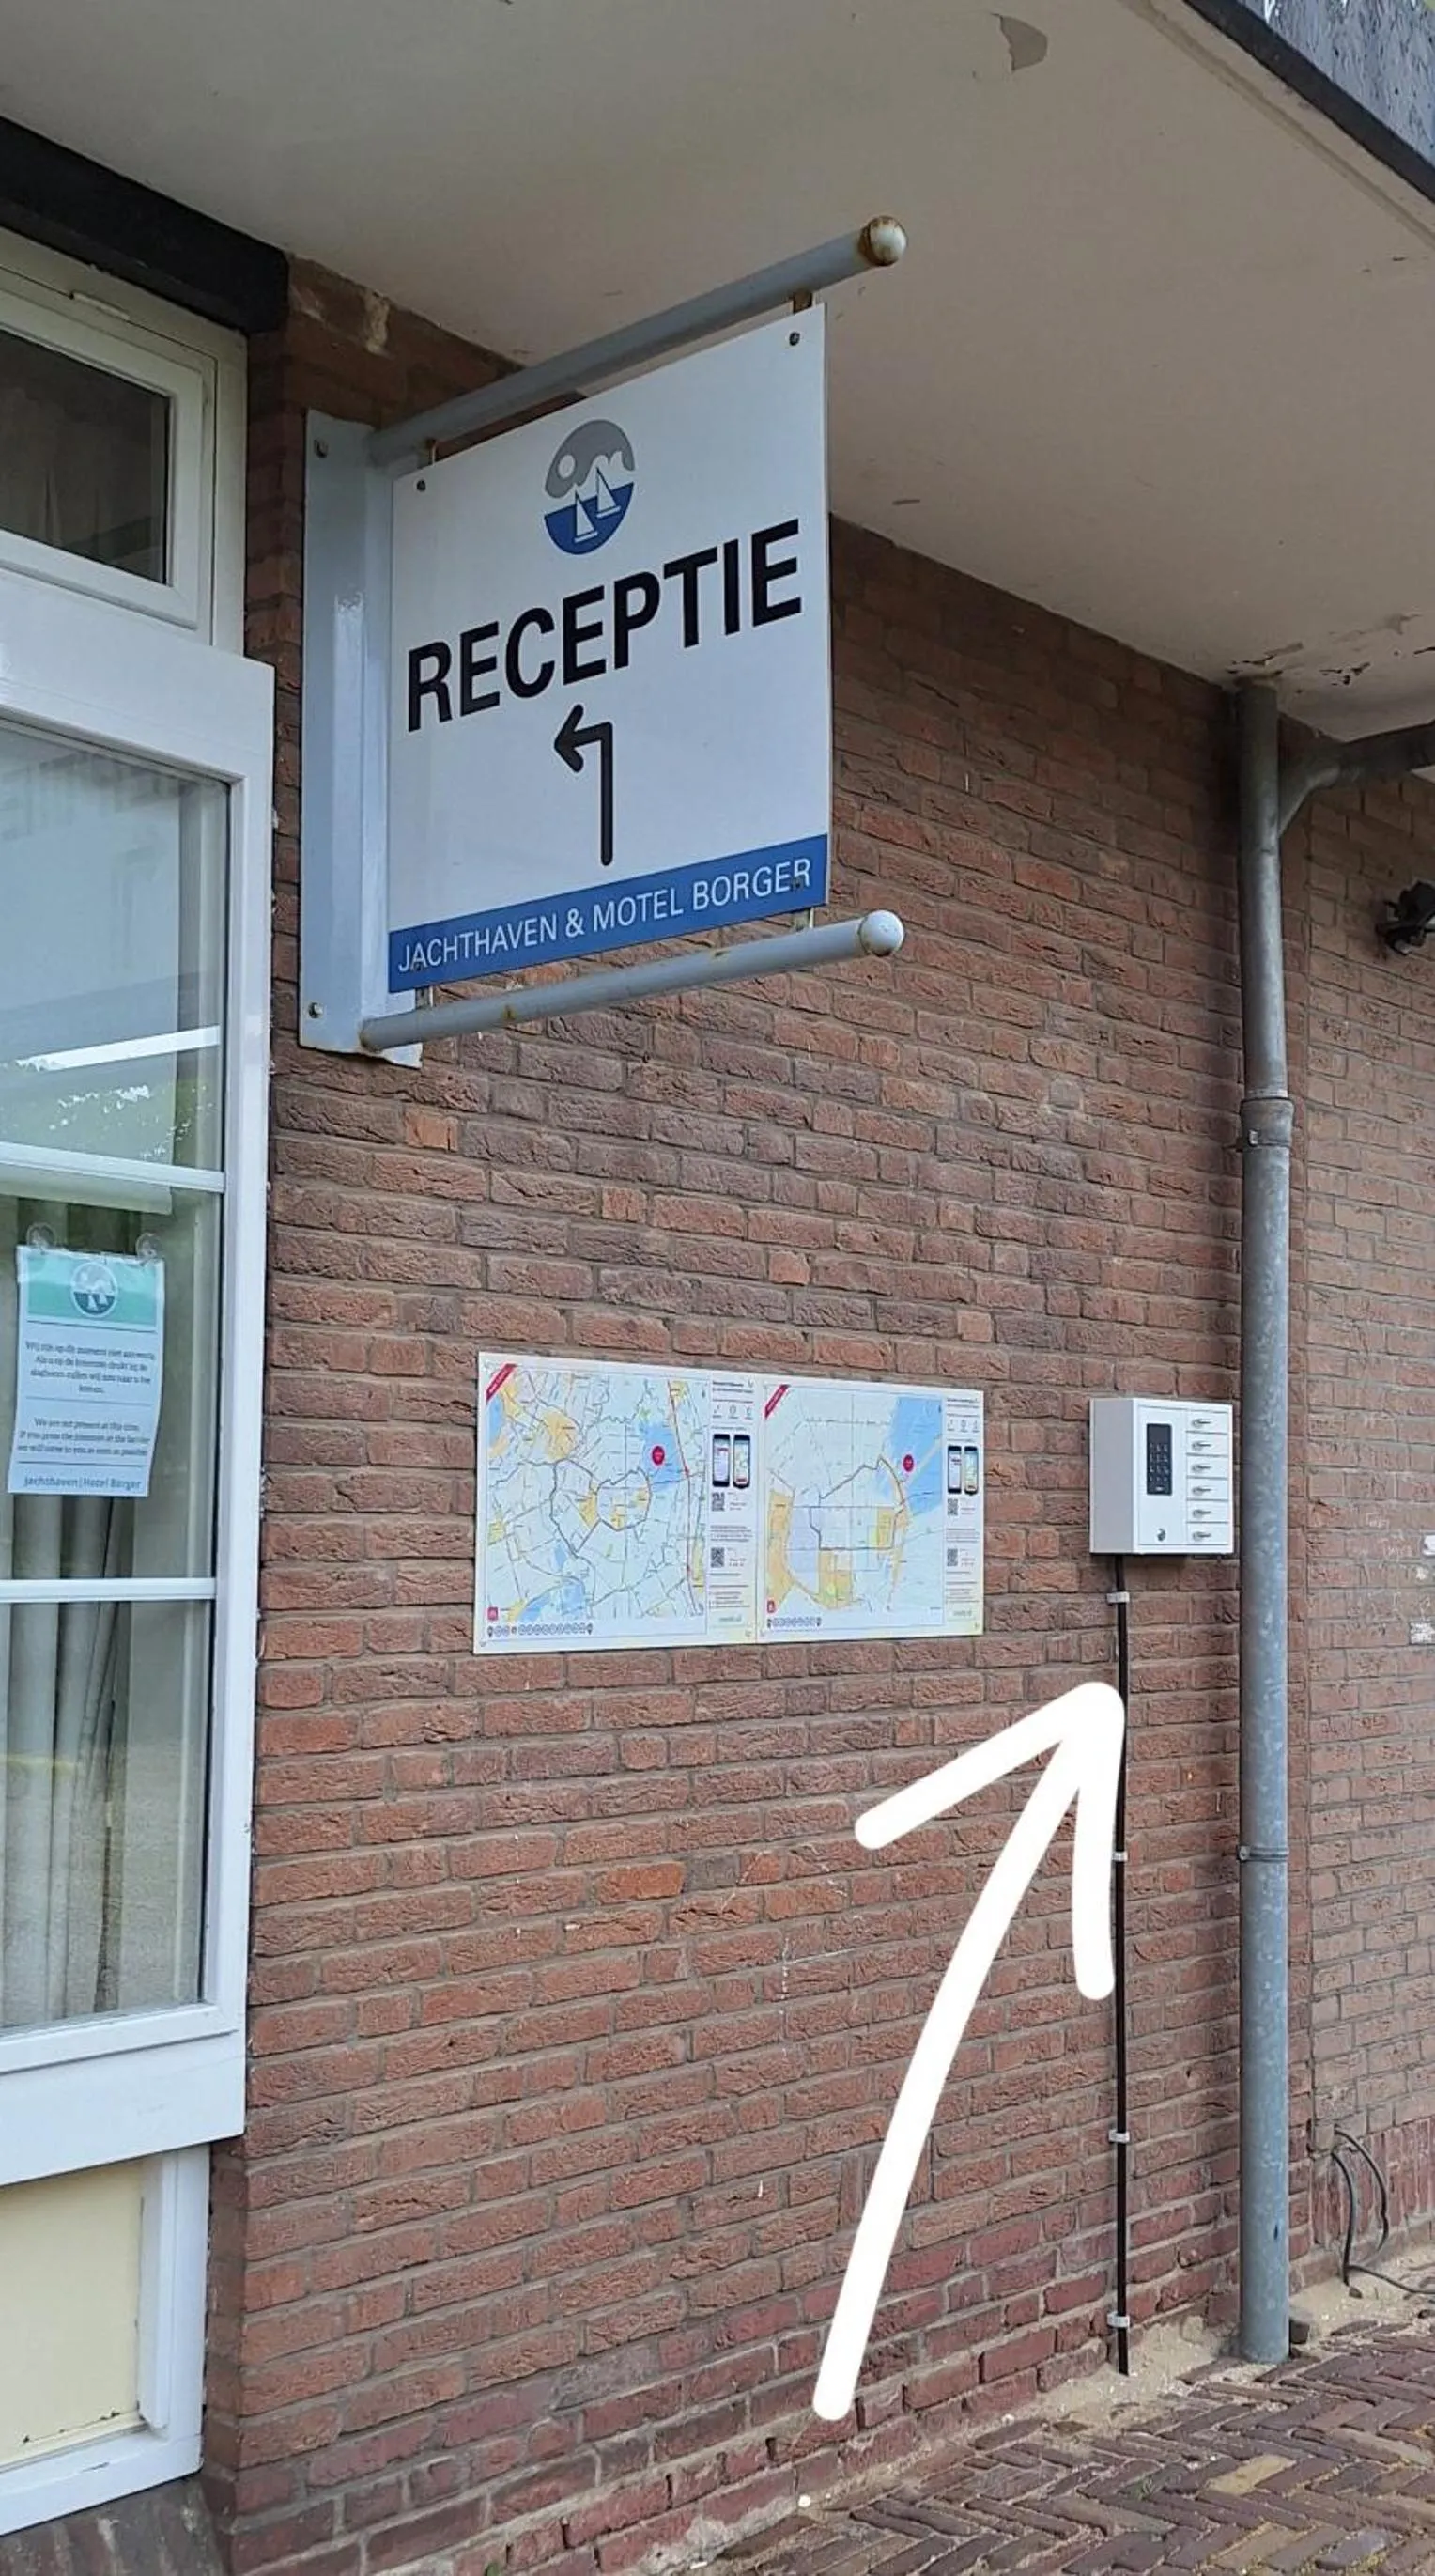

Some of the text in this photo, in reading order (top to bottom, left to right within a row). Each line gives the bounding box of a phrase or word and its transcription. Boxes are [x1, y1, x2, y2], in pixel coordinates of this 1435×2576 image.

[407, 518, 802, 732] RECEPTIE
[397, 857, 812, 974] JACHTHAVEN & MOTEL BORGER
